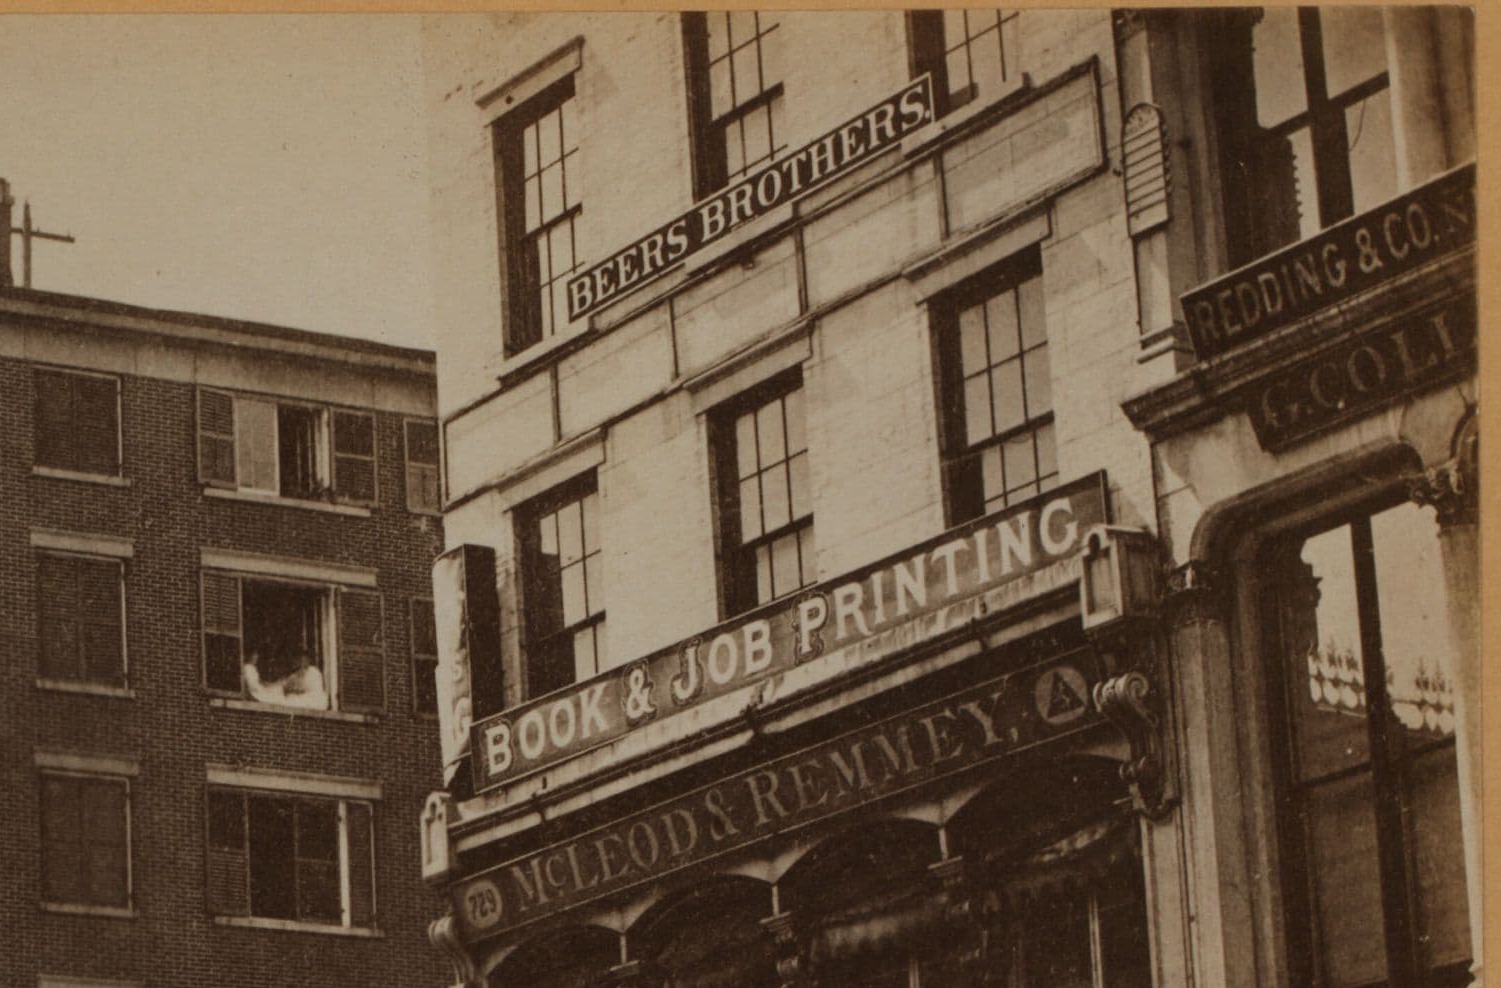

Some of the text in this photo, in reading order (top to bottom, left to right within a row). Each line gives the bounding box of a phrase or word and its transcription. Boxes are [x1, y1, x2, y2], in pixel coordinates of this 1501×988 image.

[569, 84, 932, 317] BEERS BROTHERS.
[1193, 242, 1346, 341] REDDING
[1355, 228, 1384, 275] &
[1383, 202, 1441, 259] CO.
[485, 683, 610, 777] BOOK
[624, 668, 655, 721] &
[671, 619, 774, 700] JOB
[796, 497, 1078, 656] PRINTING
[704, 788, 740, 841] &
[467, 888, 497, 922] 729
